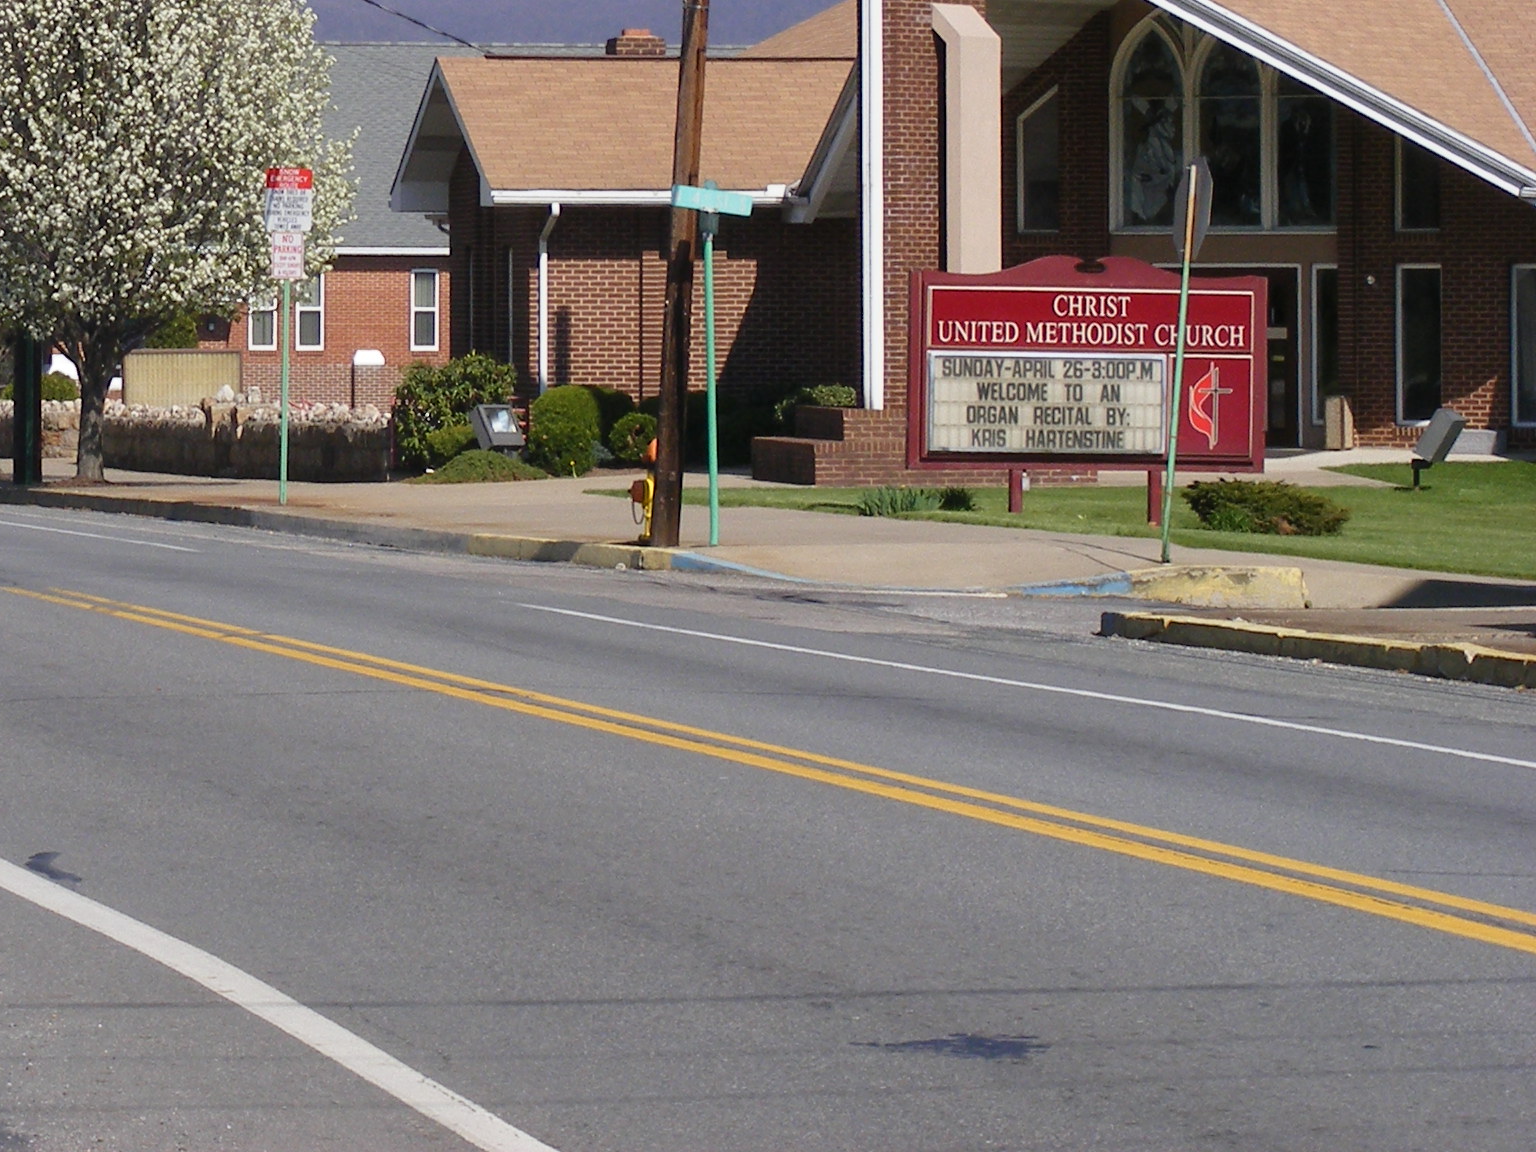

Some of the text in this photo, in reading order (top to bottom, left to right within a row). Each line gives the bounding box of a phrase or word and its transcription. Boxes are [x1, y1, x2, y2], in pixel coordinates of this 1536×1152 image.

[282, 234, 294, 244] NO
[274, 245, 302, 254] PARKING
[1053, 294, 1132, 318] CHRIST
[938, 321, 1020, 344] UNITED
[1025, 322, 1149, 346] METHODIST
[942, 359, 1056, 379] SUNDAY-APRIL
[977, 382, 1121, 403] WELCOME TO AN
[966, 405, 1131, 427] ORGAN RECITAL BY:
[971, 429, 1124, 449] KRIS HARTENSTINE
